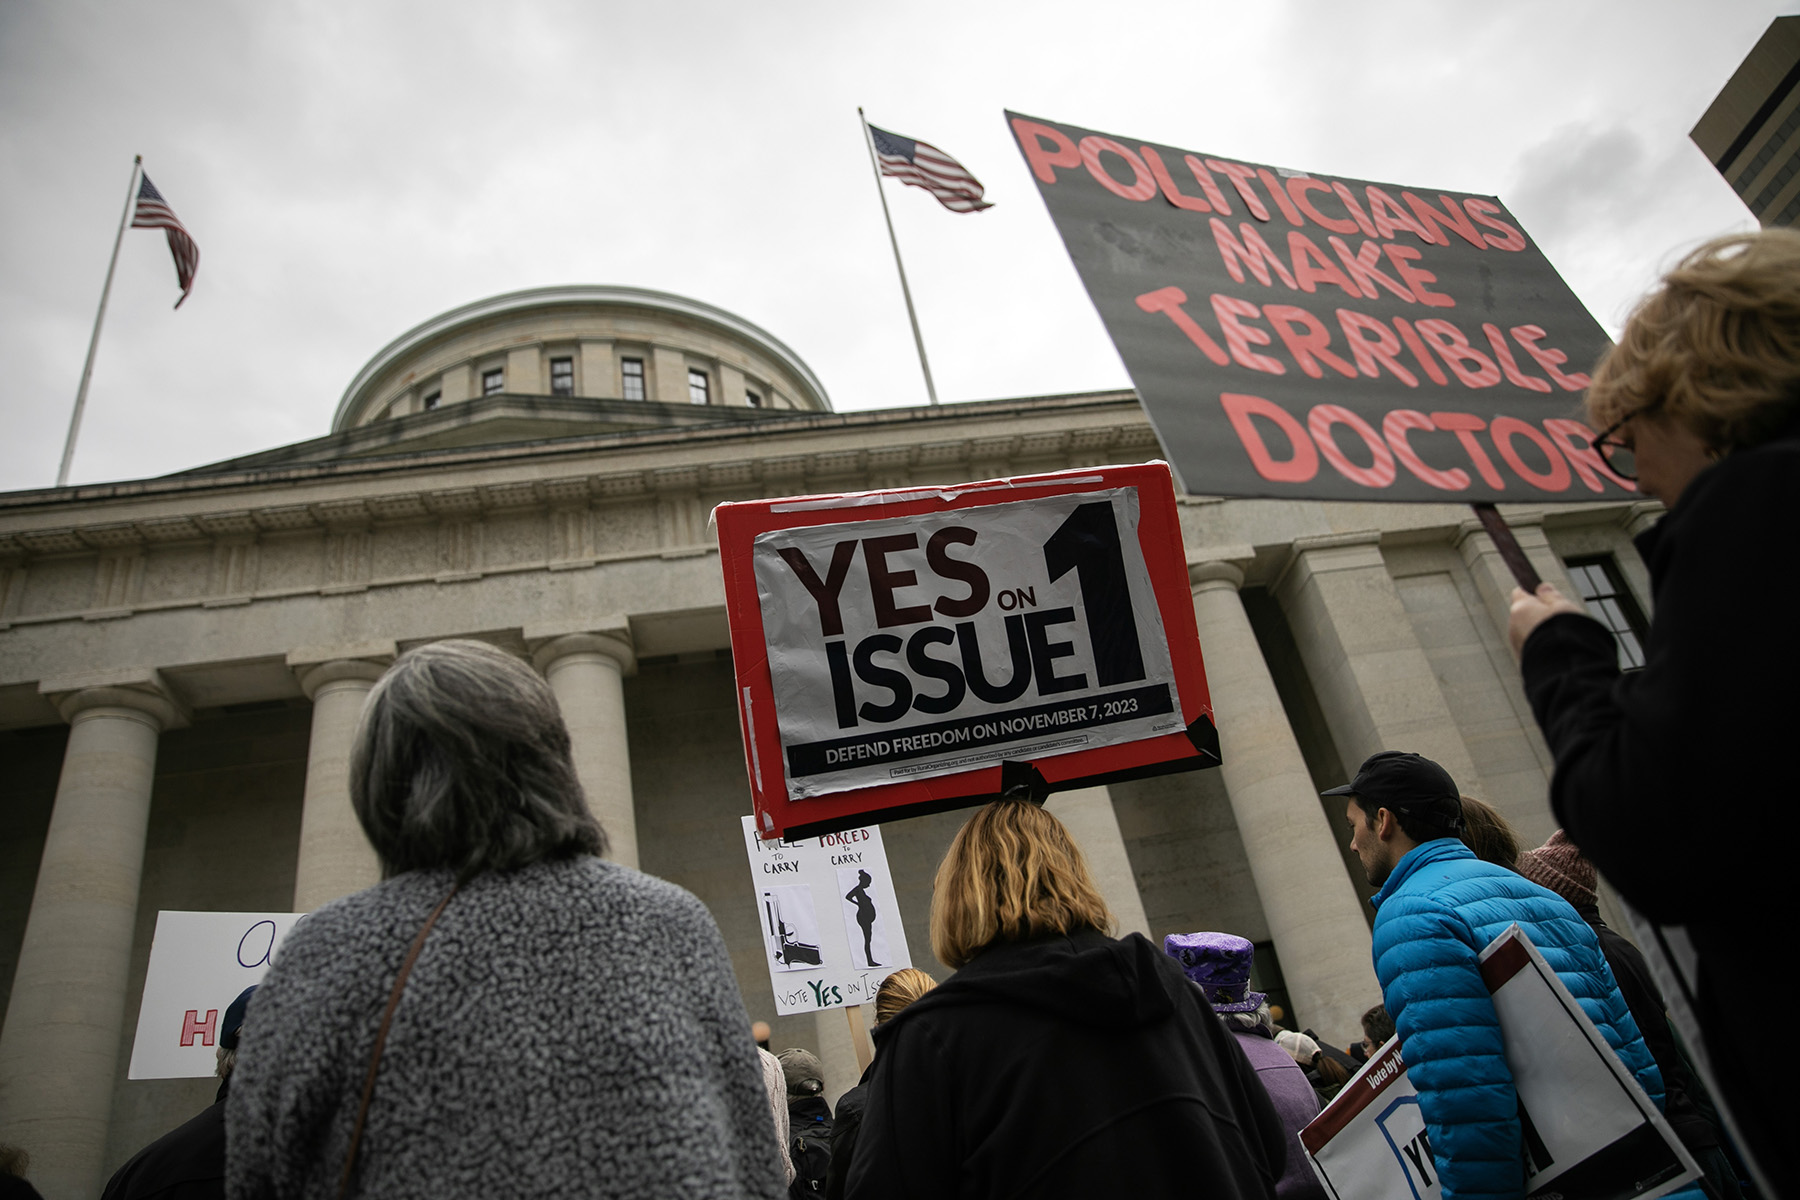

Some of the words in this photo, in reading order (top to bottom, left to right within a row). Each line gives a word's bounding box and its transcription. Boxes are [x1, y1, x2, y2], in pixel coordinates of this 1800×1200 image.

[1011, 117, 1527, 252] POLITICIANS
[1208, 217, 1456, 308] MAKE
[1135, 286, 1592, 393] TERRIBLE
[1219, 392, 1637, 493] DOCTOR
[777, 526, 991, 637] YES
[997, 586, 1037, 612] ON
[825, 606, 1089, 730] ISSUE
[1043, 500, 1147, 688] 1
[826, 741, 890, 764] DEFEND
[893, 727, 970, 753] FREEDOM
[972, 722, 998, 739] ON
[1000, 707, 1088, 735] NOVEMBER
[1088, 704, 1102, 720] 7,
[1103, 698, 1138, 716] 2023
[763, 860, 799, 875] CARRY
[772, 852, 783, 861] TO
[819, 829, 869, 848] FORCED
[831, 852, 862, 866] CARRY
[778, 989, 808, 1006] VOTE
[807, 979, 843, 1008] YES
[847, 981, 860, 994] ON
[1366, 1068, 1388, 1090] Vote
[1383, 1058, 1398, 1074] by
